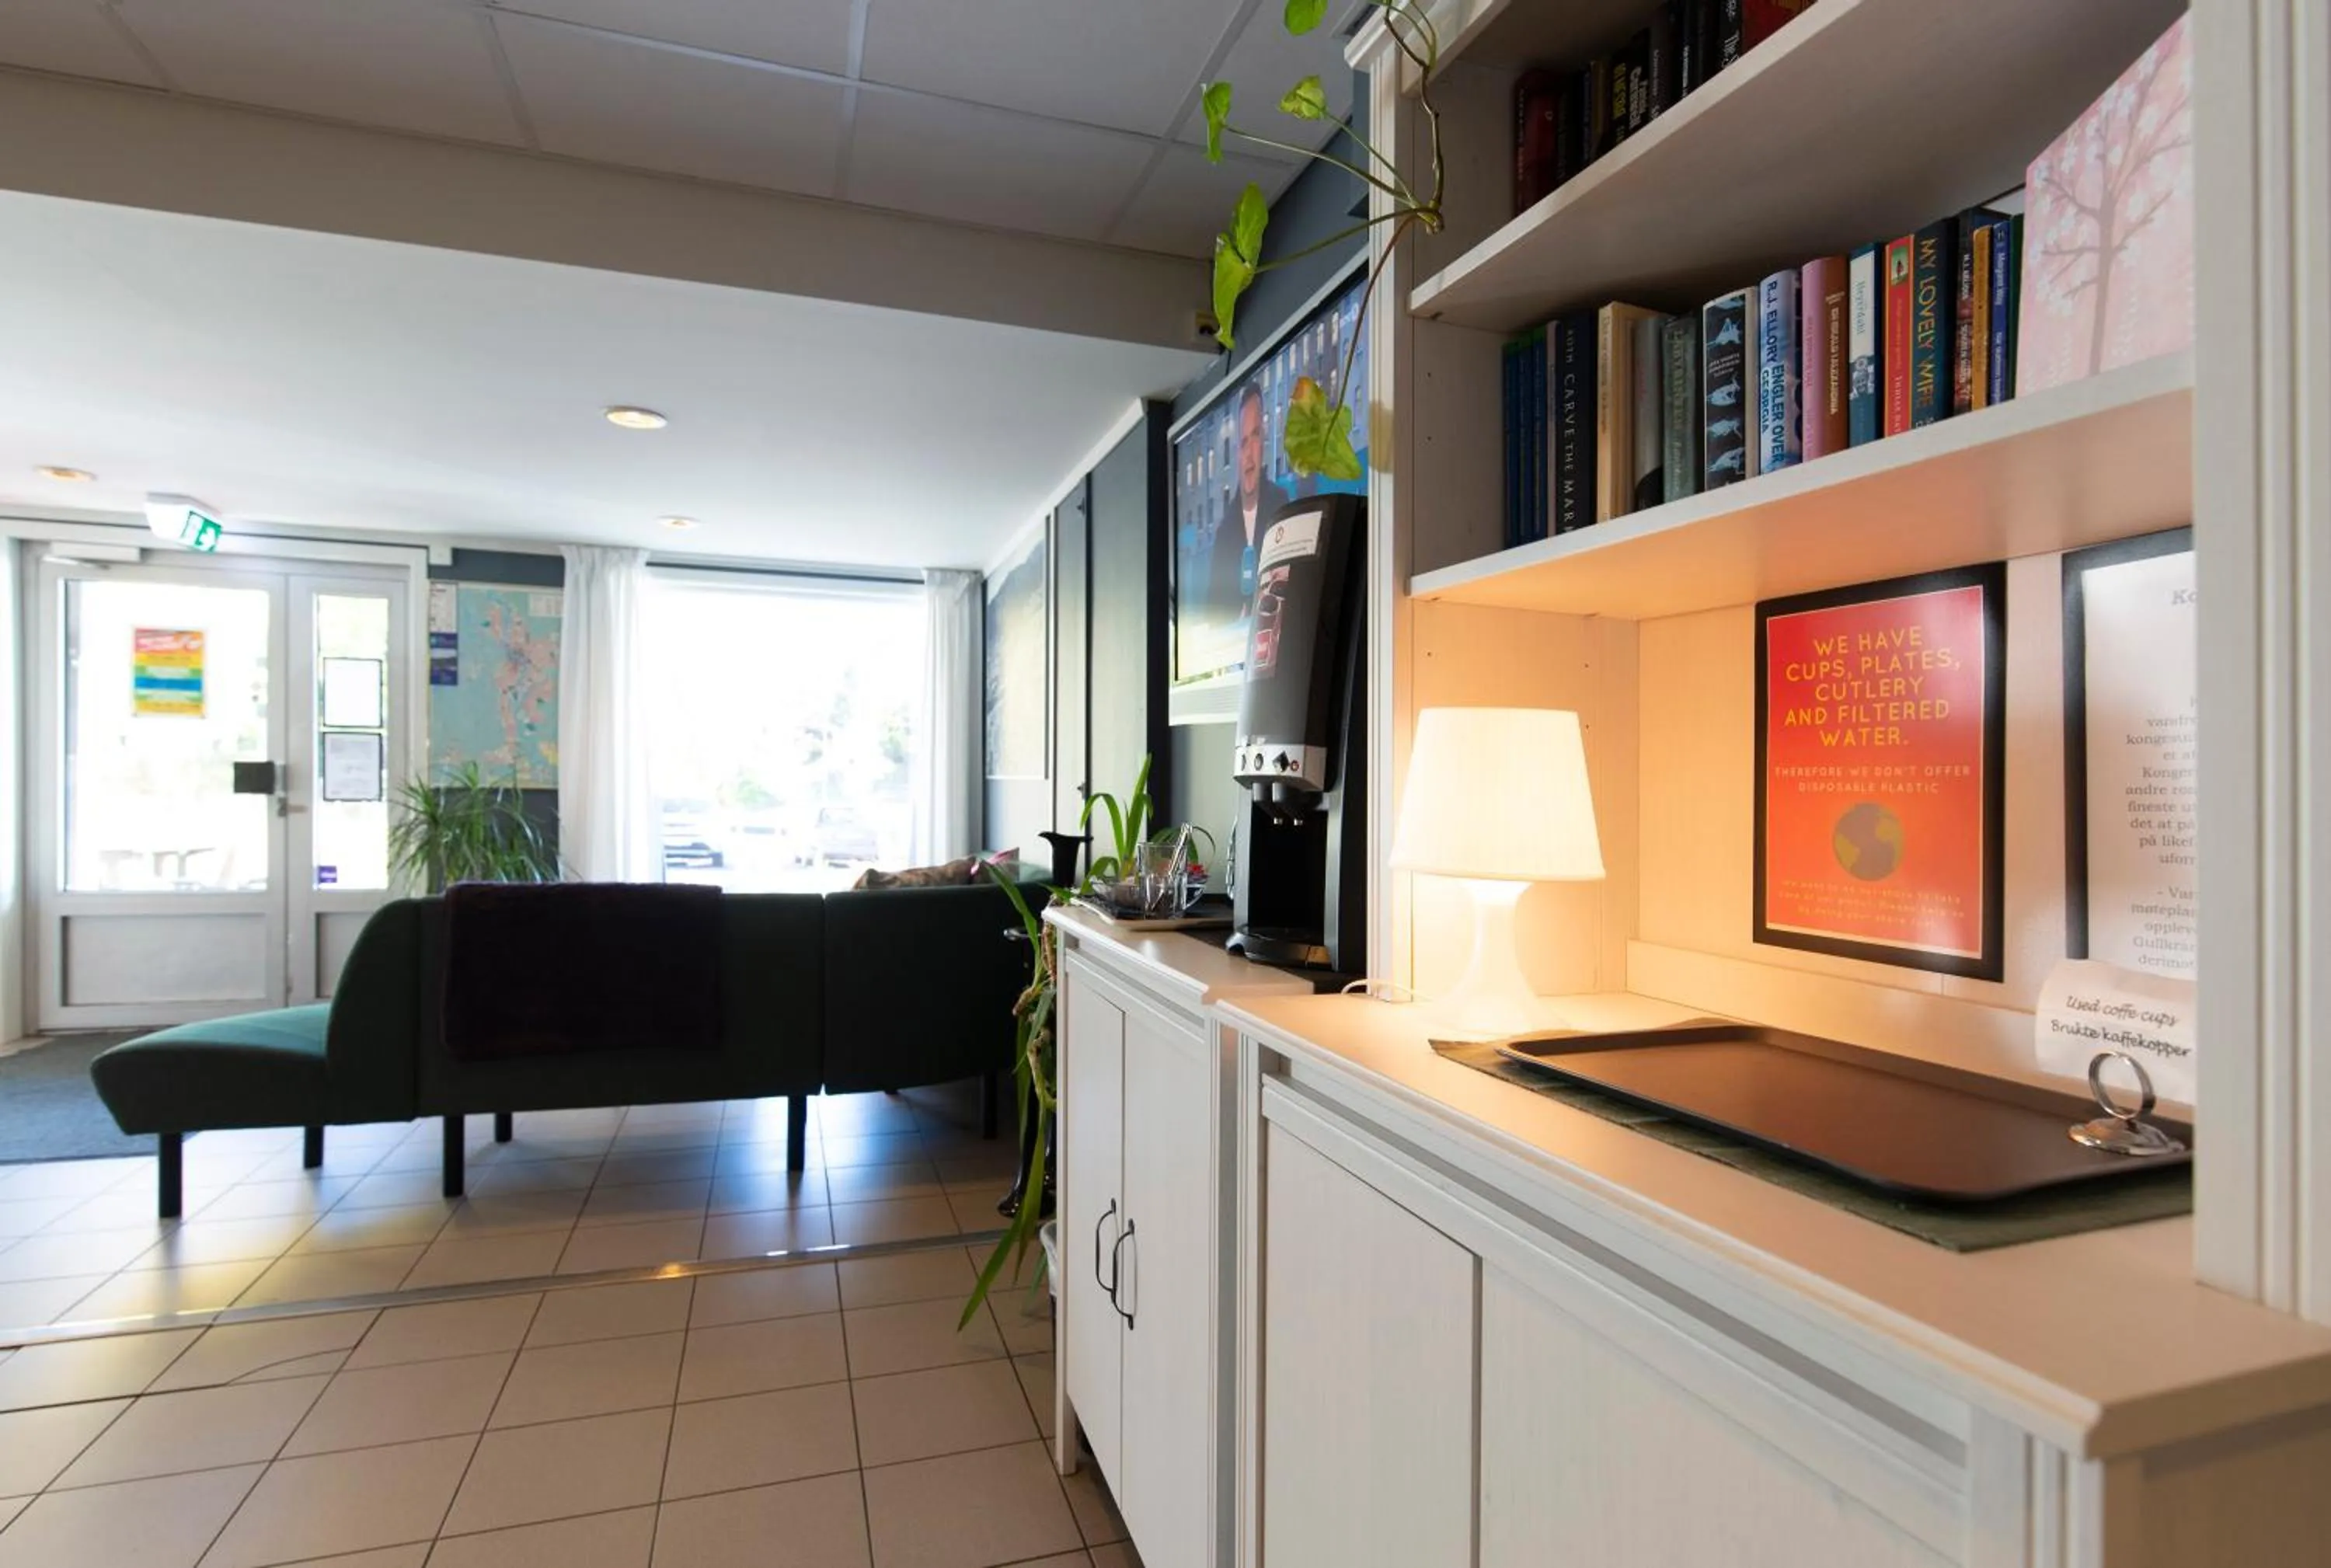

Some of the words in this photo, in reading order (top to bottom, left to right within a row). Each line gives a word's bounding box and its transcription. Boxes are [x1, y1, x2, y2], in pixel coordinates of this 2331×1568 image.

[1920, 236, 1938, 270] MY
[1766, 280, 1779, 308] R.J.
[1917, 275, 1938, 350] LOVELY
[1766, 310, 1778, 364] ELLORY
[1770, 365, 1785, 419] ENGLER
[1916, 355, 1936, 409] WIFE
[1564, 374, 1575, 438] CARVE
[1565, 443, 1574, 472] THE
[1771, 425, 1785, 463] OVER
[1814, 636, 1849, 656] WE
[1859, 625, 1923, 652] HAVE
[1786, 658, 1852, 682] CUPS,
[1861, 647, 1963, 675] PLATES,
[1815, 676, 1925, 702] CUTLERY
[1784, 706, 1828, 727] AND
[1838, 699, 1949, 724] FILTERED
[1819, 727, 1910, 747] WATER.
[1775, 766, 1843, 778] THEREFORE
[1849, 765, 1869, 778] WE
[1873, 765, 1917, 777] DON'T
[1925, 765, 1970, 777] OFFER
[1799, 781, 1876, 793] DISPOSABLE
[1881, 782, 1940, 794] PLASTIC
[2125, 783, 2168, 796] andre
[2130, 817, 2152, 829] det
[2066, 995, 2101, 1012] Used
[2103, 1003, 2138, 1020] coffe
[2140, 1012, 2180, 1030] cups
[2051, 1019, 2100, 1039] Brukte
[2102, 1026, 2192, 1058] kaffekopper
